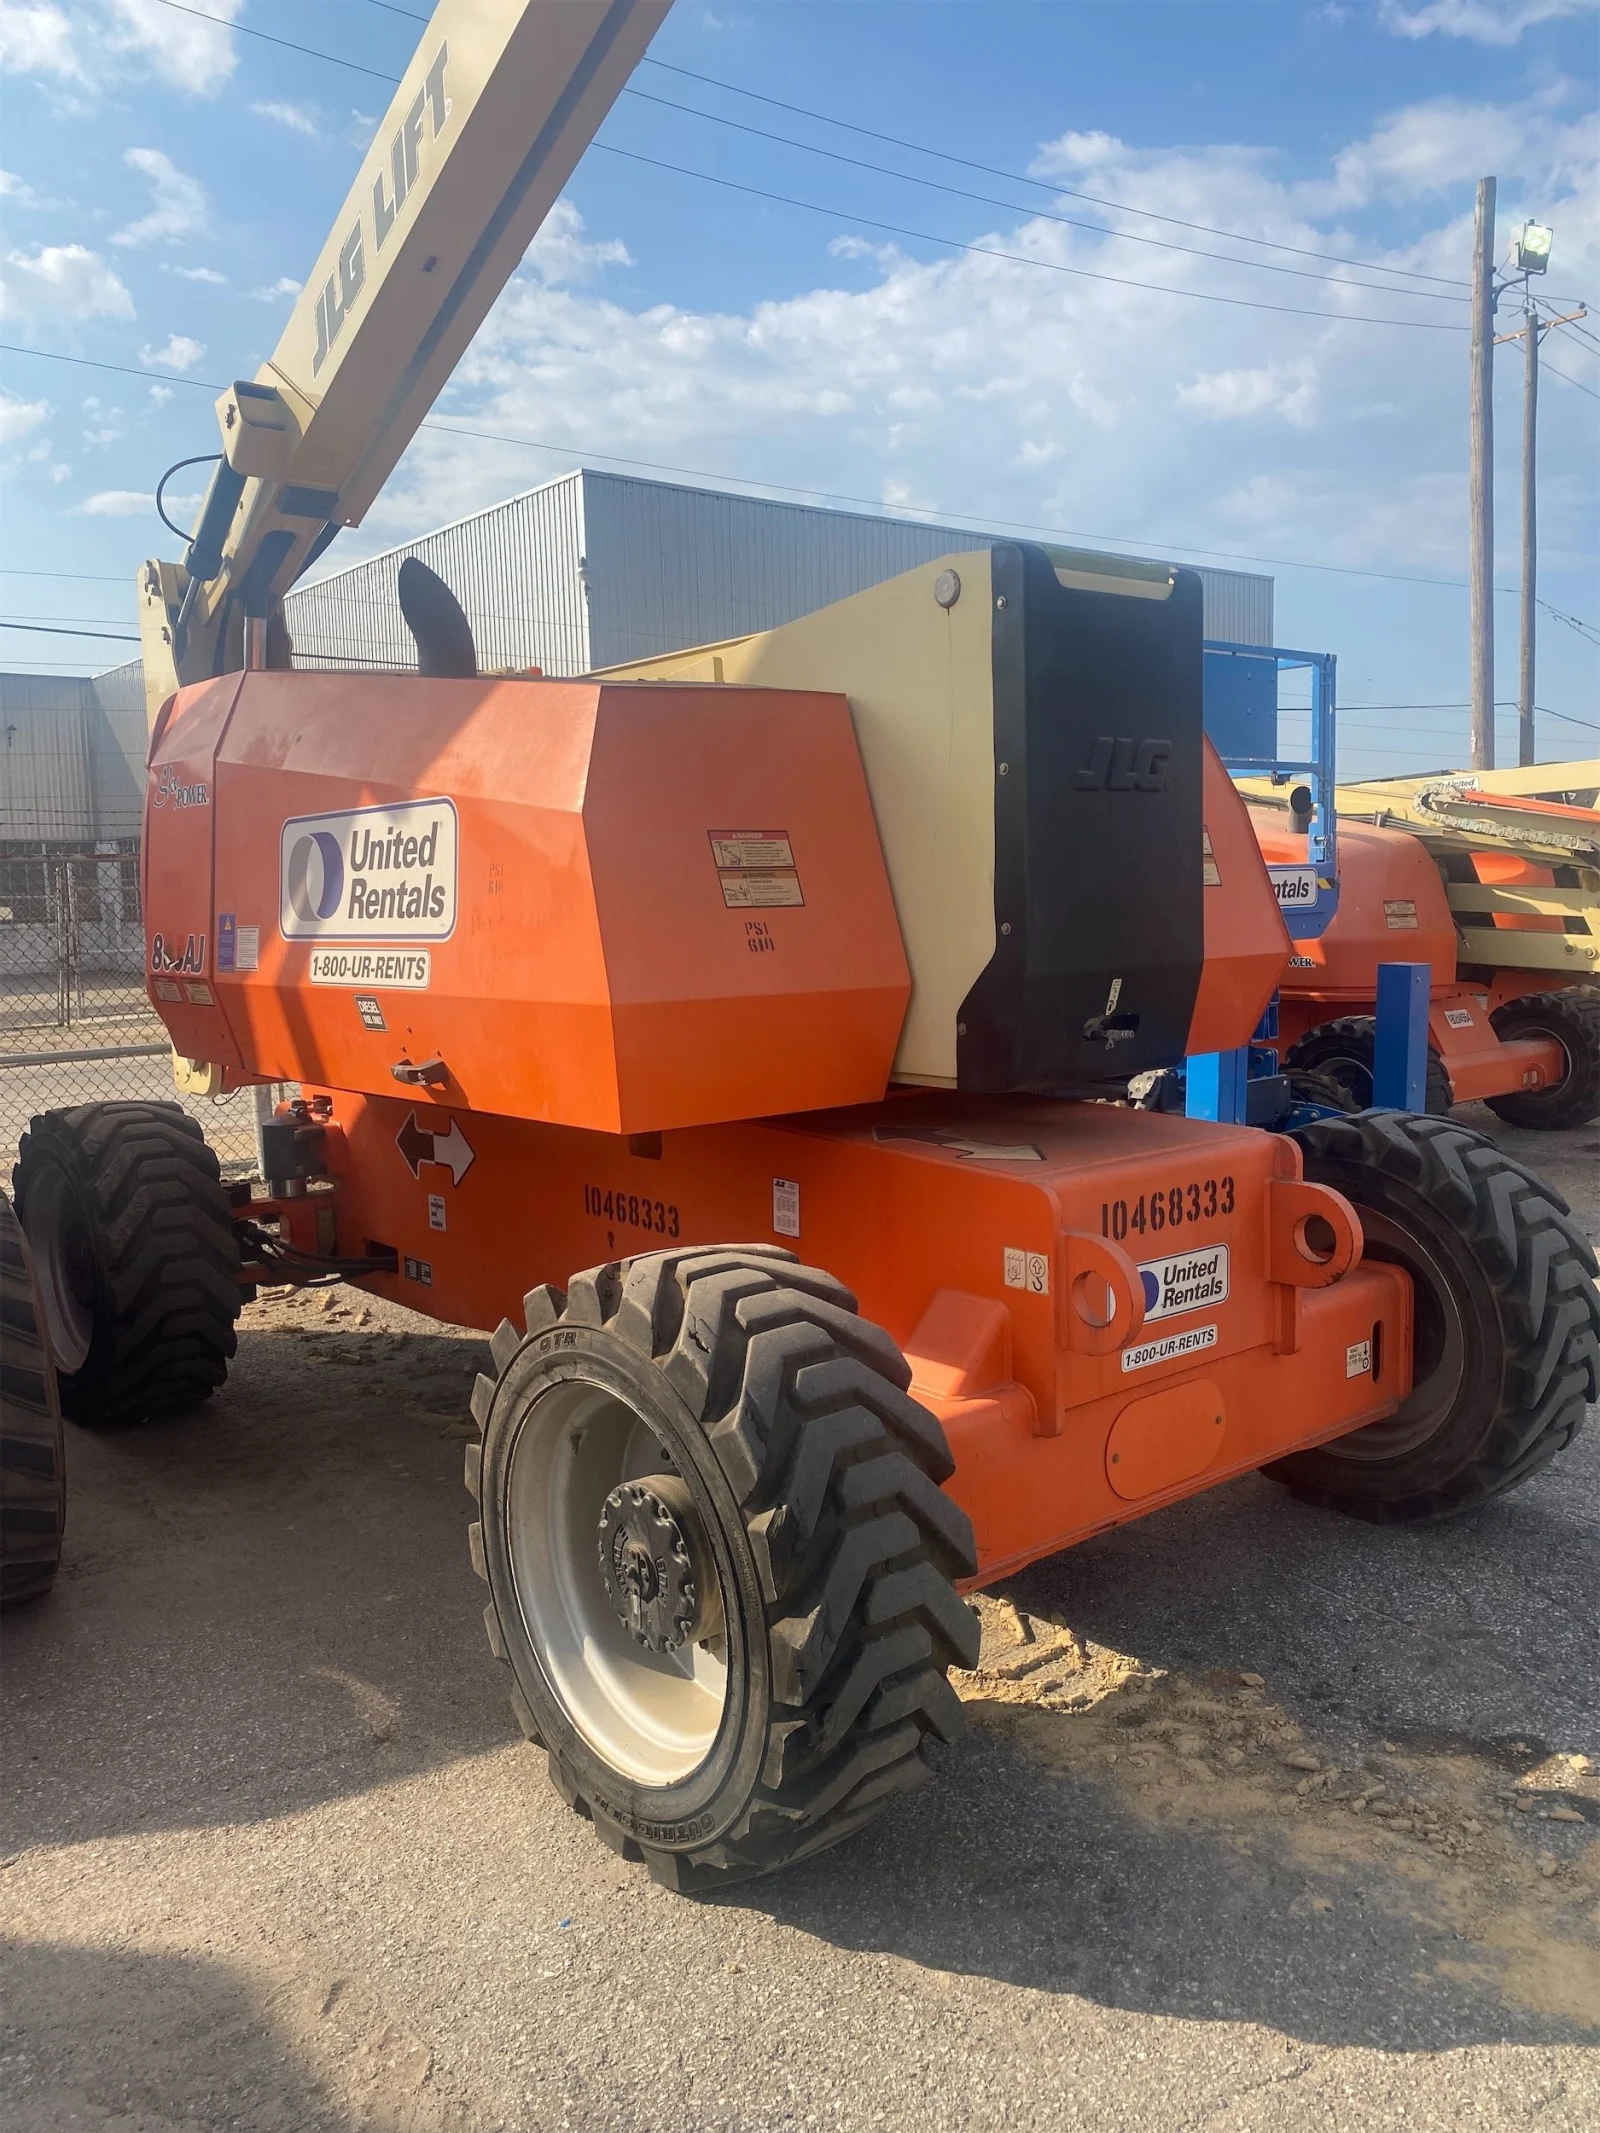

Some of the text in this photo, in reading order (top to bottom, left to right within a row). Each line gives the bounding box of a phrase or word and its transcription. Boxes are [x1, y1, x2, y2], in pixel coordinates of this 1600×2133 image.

[312, 36, 449, 381] JLG LIFT
[1072, 737, 1171, 792] JLG
[176, 784, 207, 808] POWER
[350, 821, 438, 872] United
[348, 873, 445, 919] Rentals
[745, 921, 769, 936] PSI
[313, 956, 426, 981] 1-800-UR-RENTS
[358, 1000, 380, 1014] DIESEL
[584, 1184, 680, 1238] 10468333
[1102, 1176, 1235, 1240] 10468333
[1163, 1254, 1219, 1286] United
[1162, 1277, 1223, 1309] Rentals
[540, 1331, 577, 1353] OTR
[1125, 1328, 1214, 1367] 1-800-UR-RENTS
